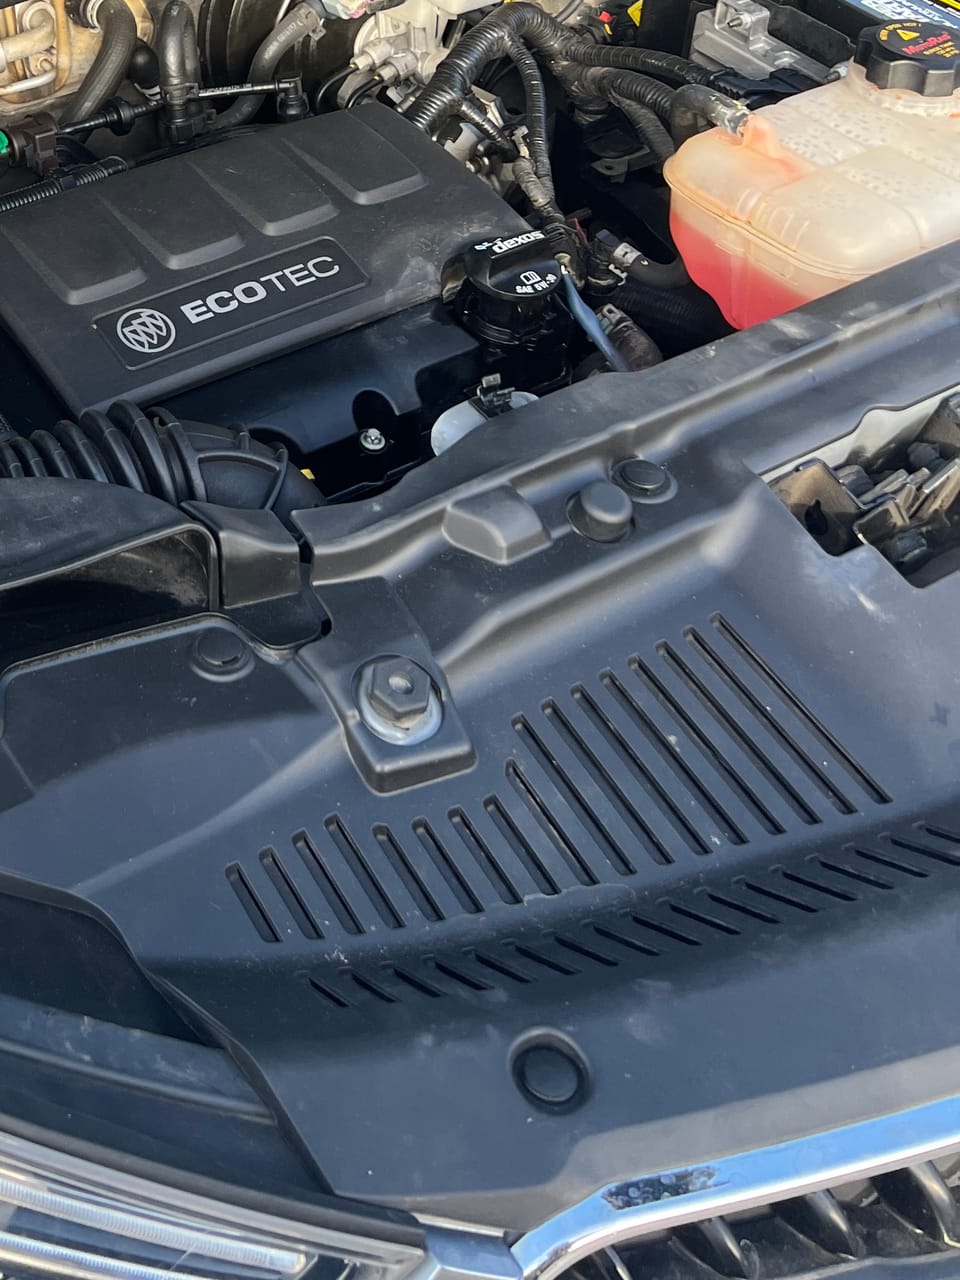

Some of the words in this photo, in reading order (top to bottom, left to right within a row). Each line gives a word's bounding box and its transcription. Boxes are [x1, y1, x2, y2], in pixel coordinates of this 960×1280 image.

[492, 230, 545, 253] dexos
[180, 256, 340, 325] ECOTEC
[515, 285, 535, 294] SAE
